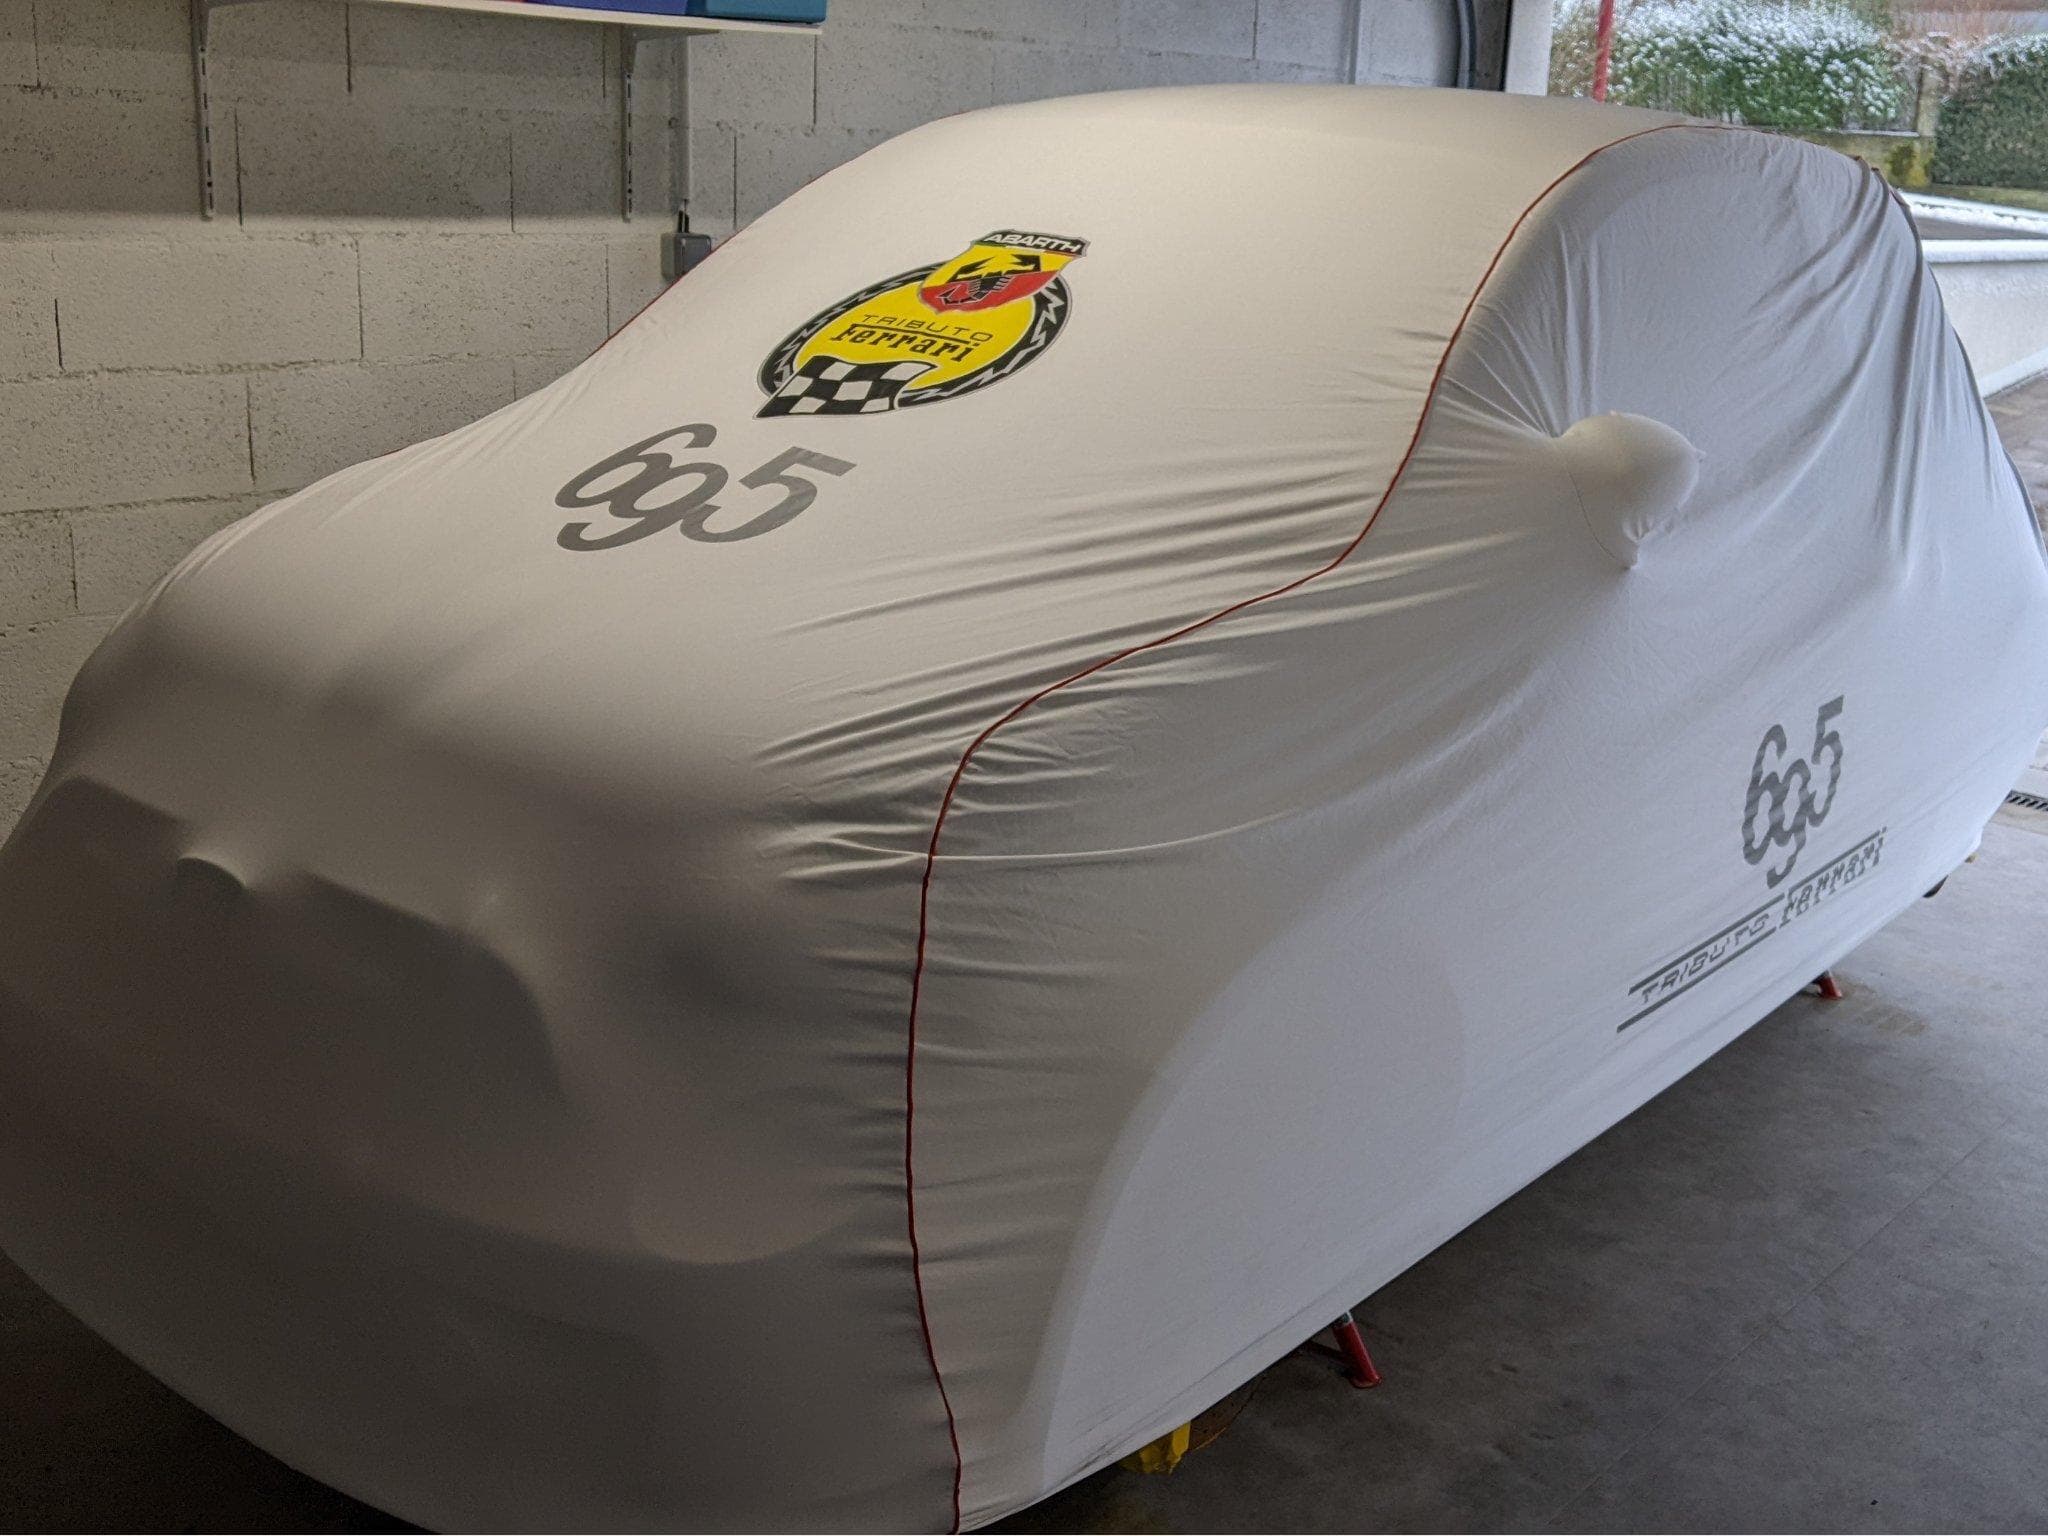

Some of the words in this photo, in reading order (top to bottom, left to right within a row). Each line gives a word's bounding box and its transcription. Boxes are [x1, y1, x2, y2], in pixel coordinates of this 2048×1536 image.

[983, 233, 1083, 254] ABARTH
[829, 323, 982, 363] Ferrari
[861, 313, 995, 343] TRIBUTO
[555, 423, 857, 552] 695
[1741, 694, 1845, 889] 695
